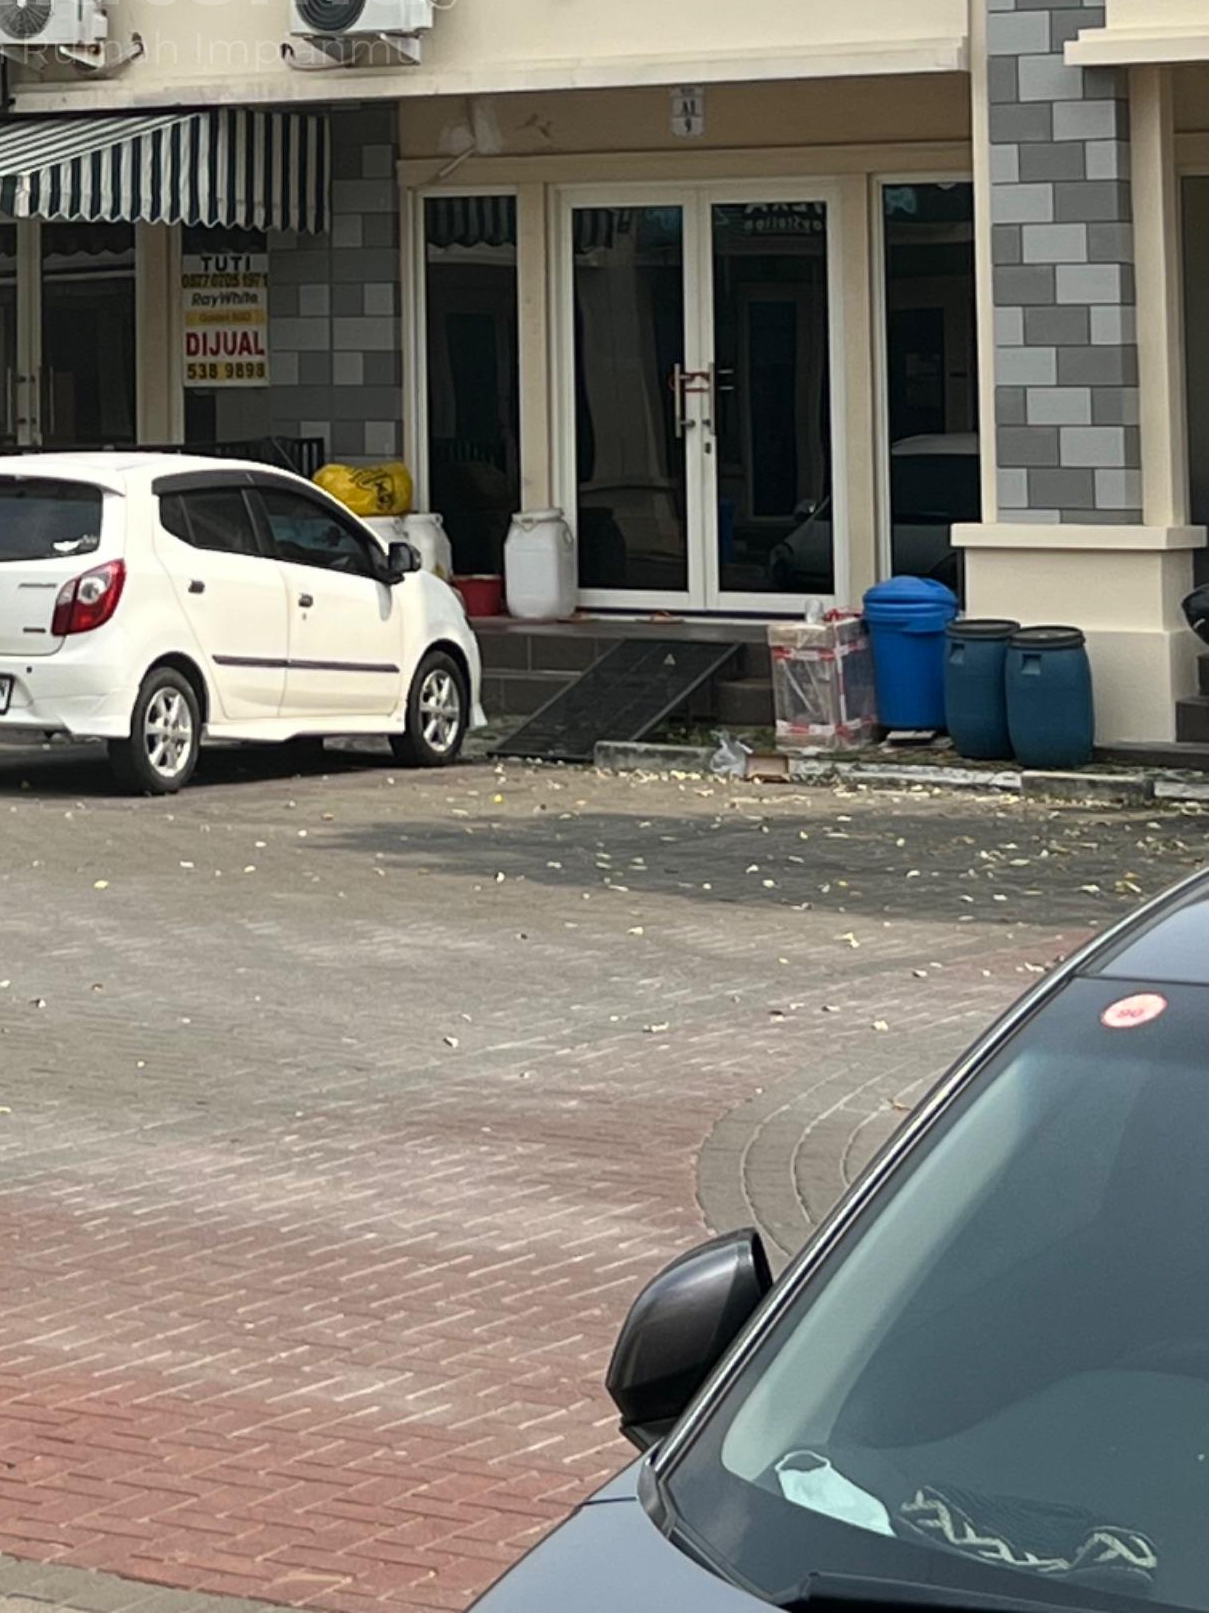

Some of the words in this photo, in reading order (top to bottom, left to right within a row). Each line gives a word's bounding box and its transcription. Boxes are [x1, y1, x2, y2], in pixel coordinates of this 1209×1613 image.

[200, 255, 251, 272] TUTI
[185, 331, 266, 356] DIJUAL
[186, 363, 218, 380] 538
